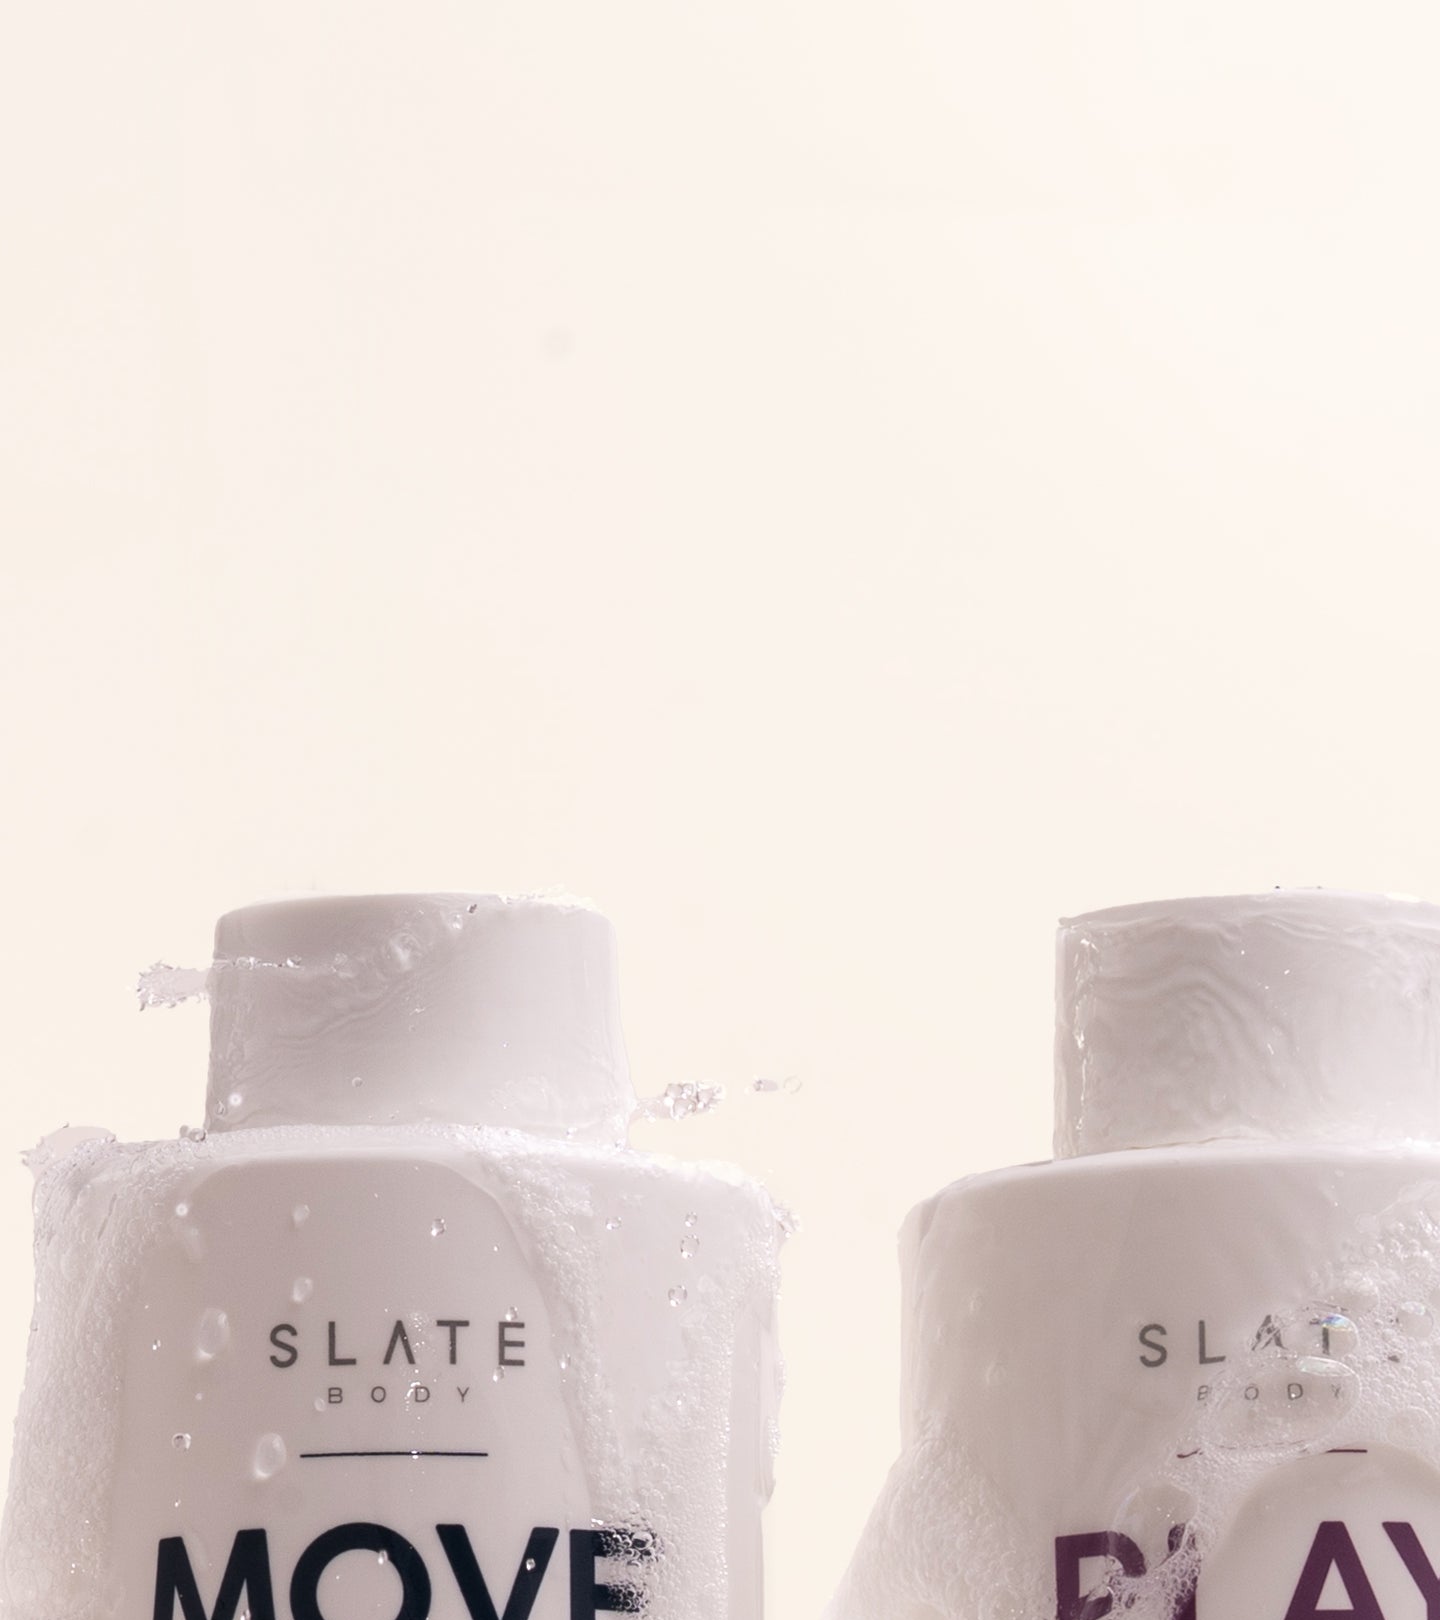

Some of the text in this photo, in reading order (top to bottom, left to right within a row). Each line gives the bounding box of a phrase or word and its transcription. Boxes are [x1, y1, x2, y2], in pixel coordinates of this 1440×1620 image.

[269, 1320, 525, 1368] SLATE
[1138, 1315, 1400, 1368] SLAT
[328, 1385, 470, 1404] BODY
